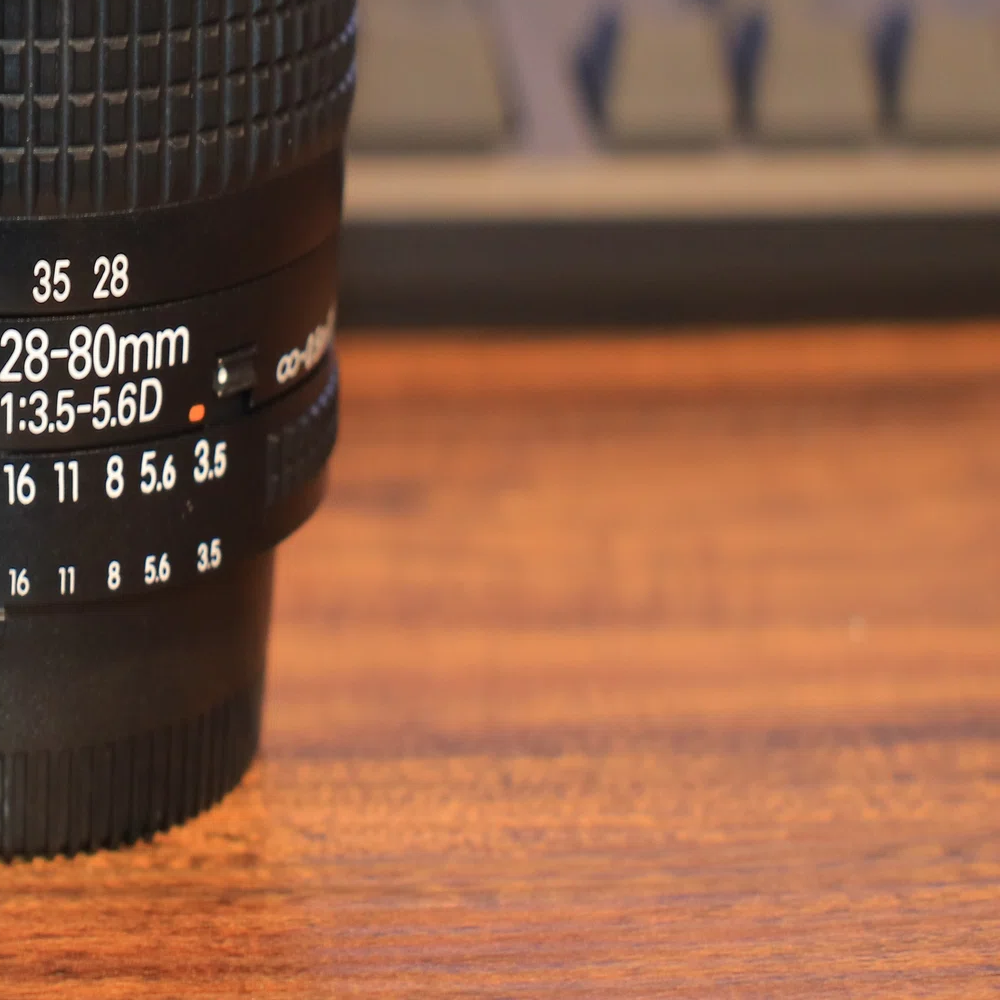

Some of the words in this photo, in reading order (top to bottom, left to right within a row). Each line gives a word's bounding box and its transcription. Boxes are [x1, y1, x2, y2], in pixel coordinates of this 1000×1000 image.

[32, 259, 71, 304] 35
[92, 253, 129, 299] 28
[0, 323, 190, 383] 28-80mm
[0, 377, 163, 435] 1:3.5-5.6D
[3, 462, 36, 506] 16
[53, 460, 79, 504] 11
[105, 454, 125, 499] 8
[140, 450, 177, 494] 5.6
[193, 438, 227, 483] 3.5
[8, 567, 30, 597] 16
[58, 566, 75, 595] 11
[107, 560, 121, 591] 8
[144, 552, 171, 585] 5.6
[197, 538, 222, 573] 3.5
